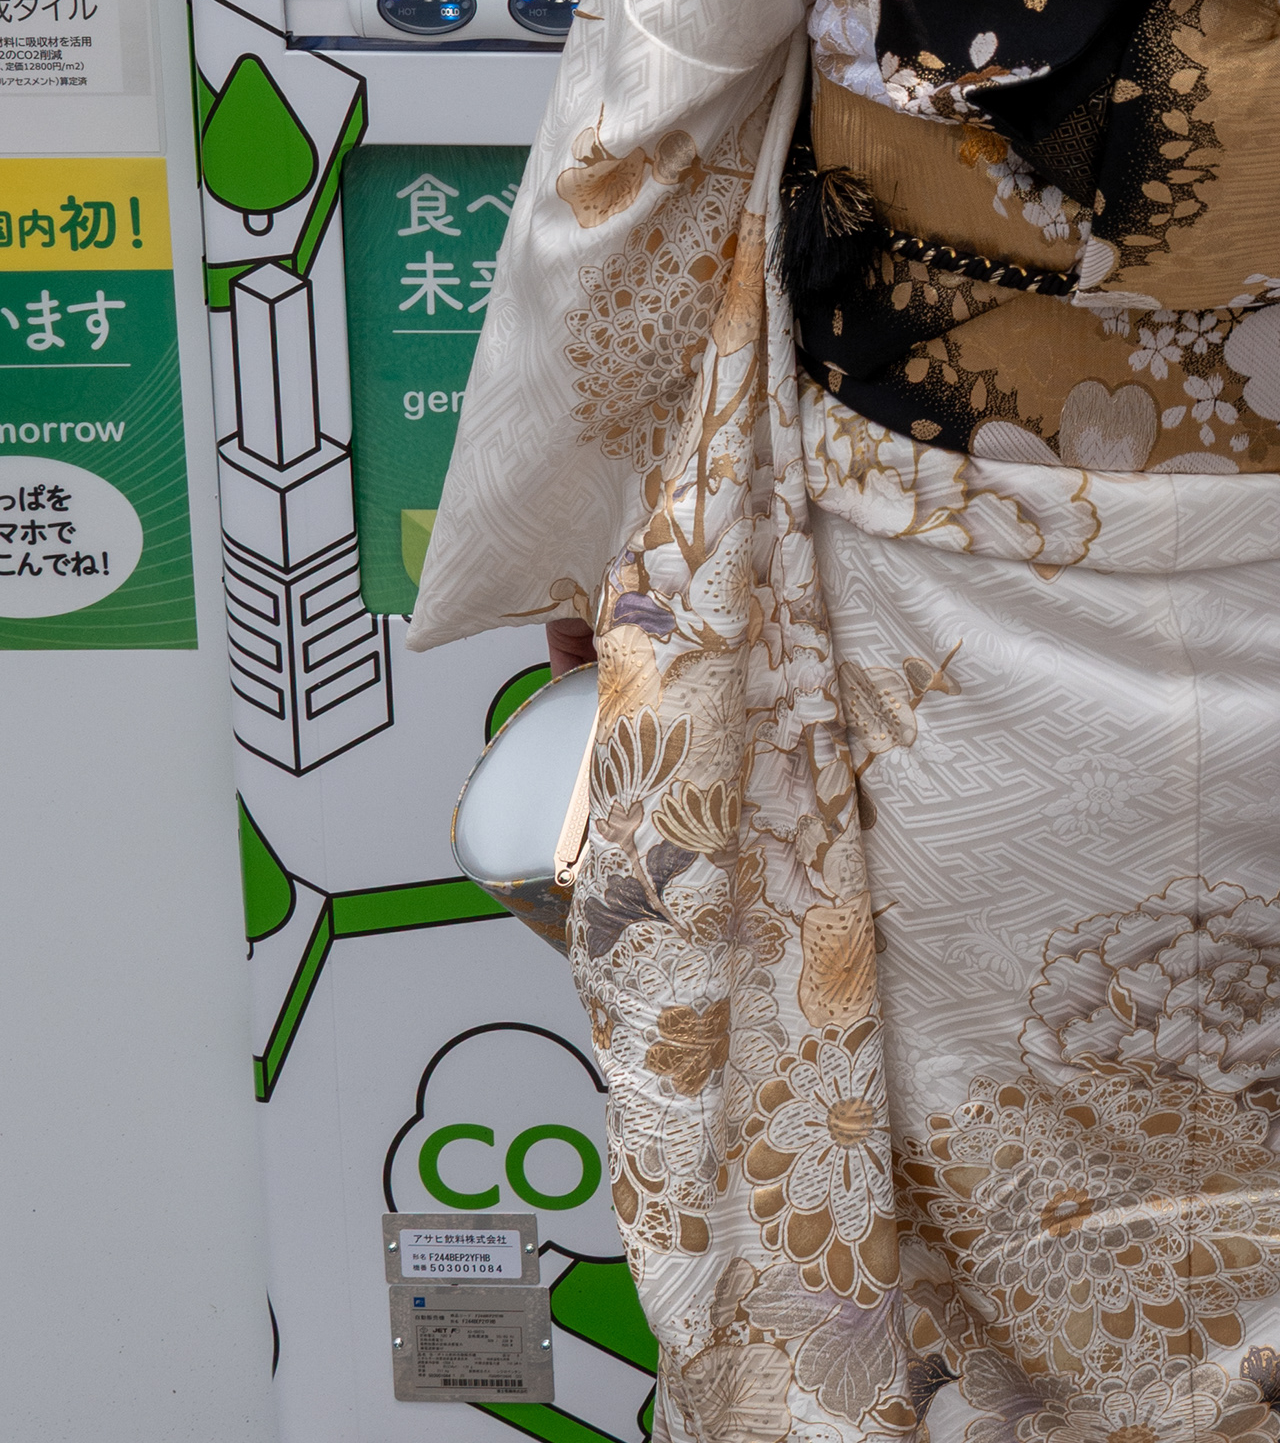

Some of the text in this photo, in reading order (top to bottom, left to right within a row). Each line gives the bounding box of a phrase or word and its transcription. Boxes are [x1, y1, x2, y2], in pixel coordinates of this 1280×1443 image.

[418, 1122, 603, 1212] CO
[413, 1234, 507, 1245] アサヒ飲料株式会社
[430, 1264, 503, 1273] 503001084
